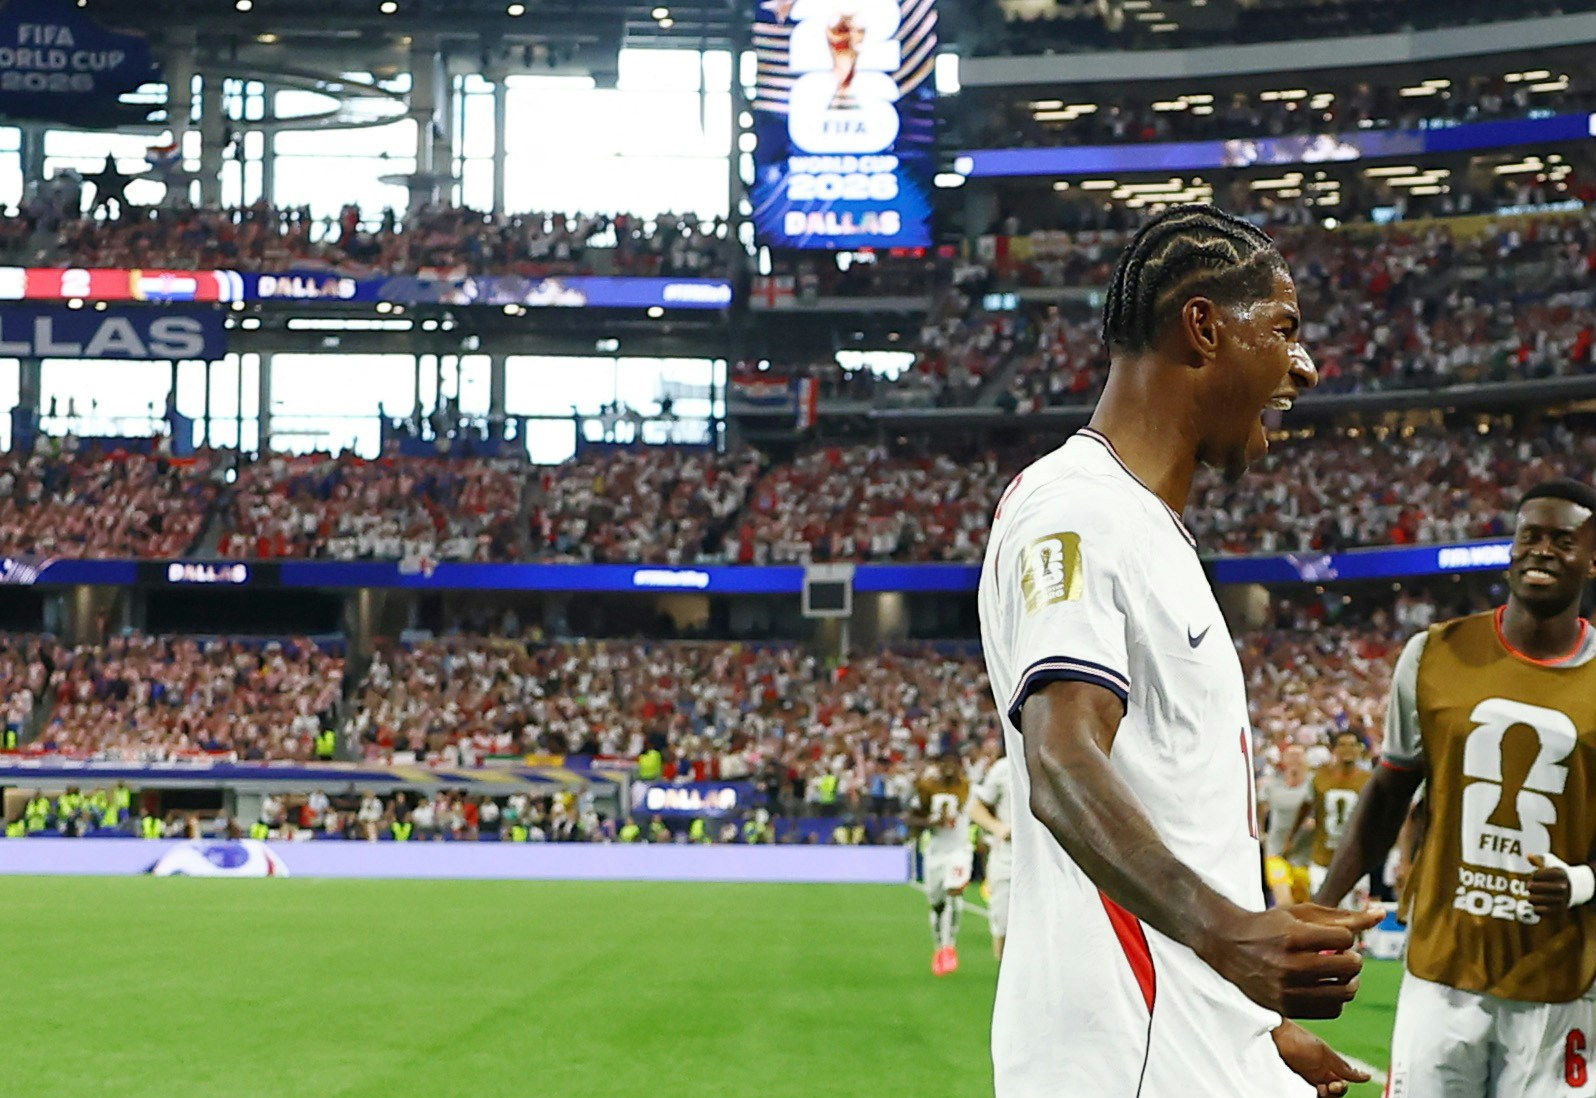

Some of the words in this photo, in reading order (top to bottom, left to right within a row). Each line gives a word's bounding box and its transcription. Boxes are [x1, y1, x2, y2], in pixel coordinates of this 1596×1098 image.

[18, 24, 74, 46] FIFA
[0, 47, 67, 69] ORLD
[72, 51, 125, 71] CUP
[787, 173, 899, 200] 2026
[784, 210, 900, 236] DALLAS
[258, 275, 356, 299] DALLAS
[0, 315, 205, 357] LLAS
[168, 563, 247, 583] DALLAS
[1479, 833, 1522, 857] FIFA
[1459, 867, 1508, 892] ORLD
[1565, 1028, 1588, 1088] 6
